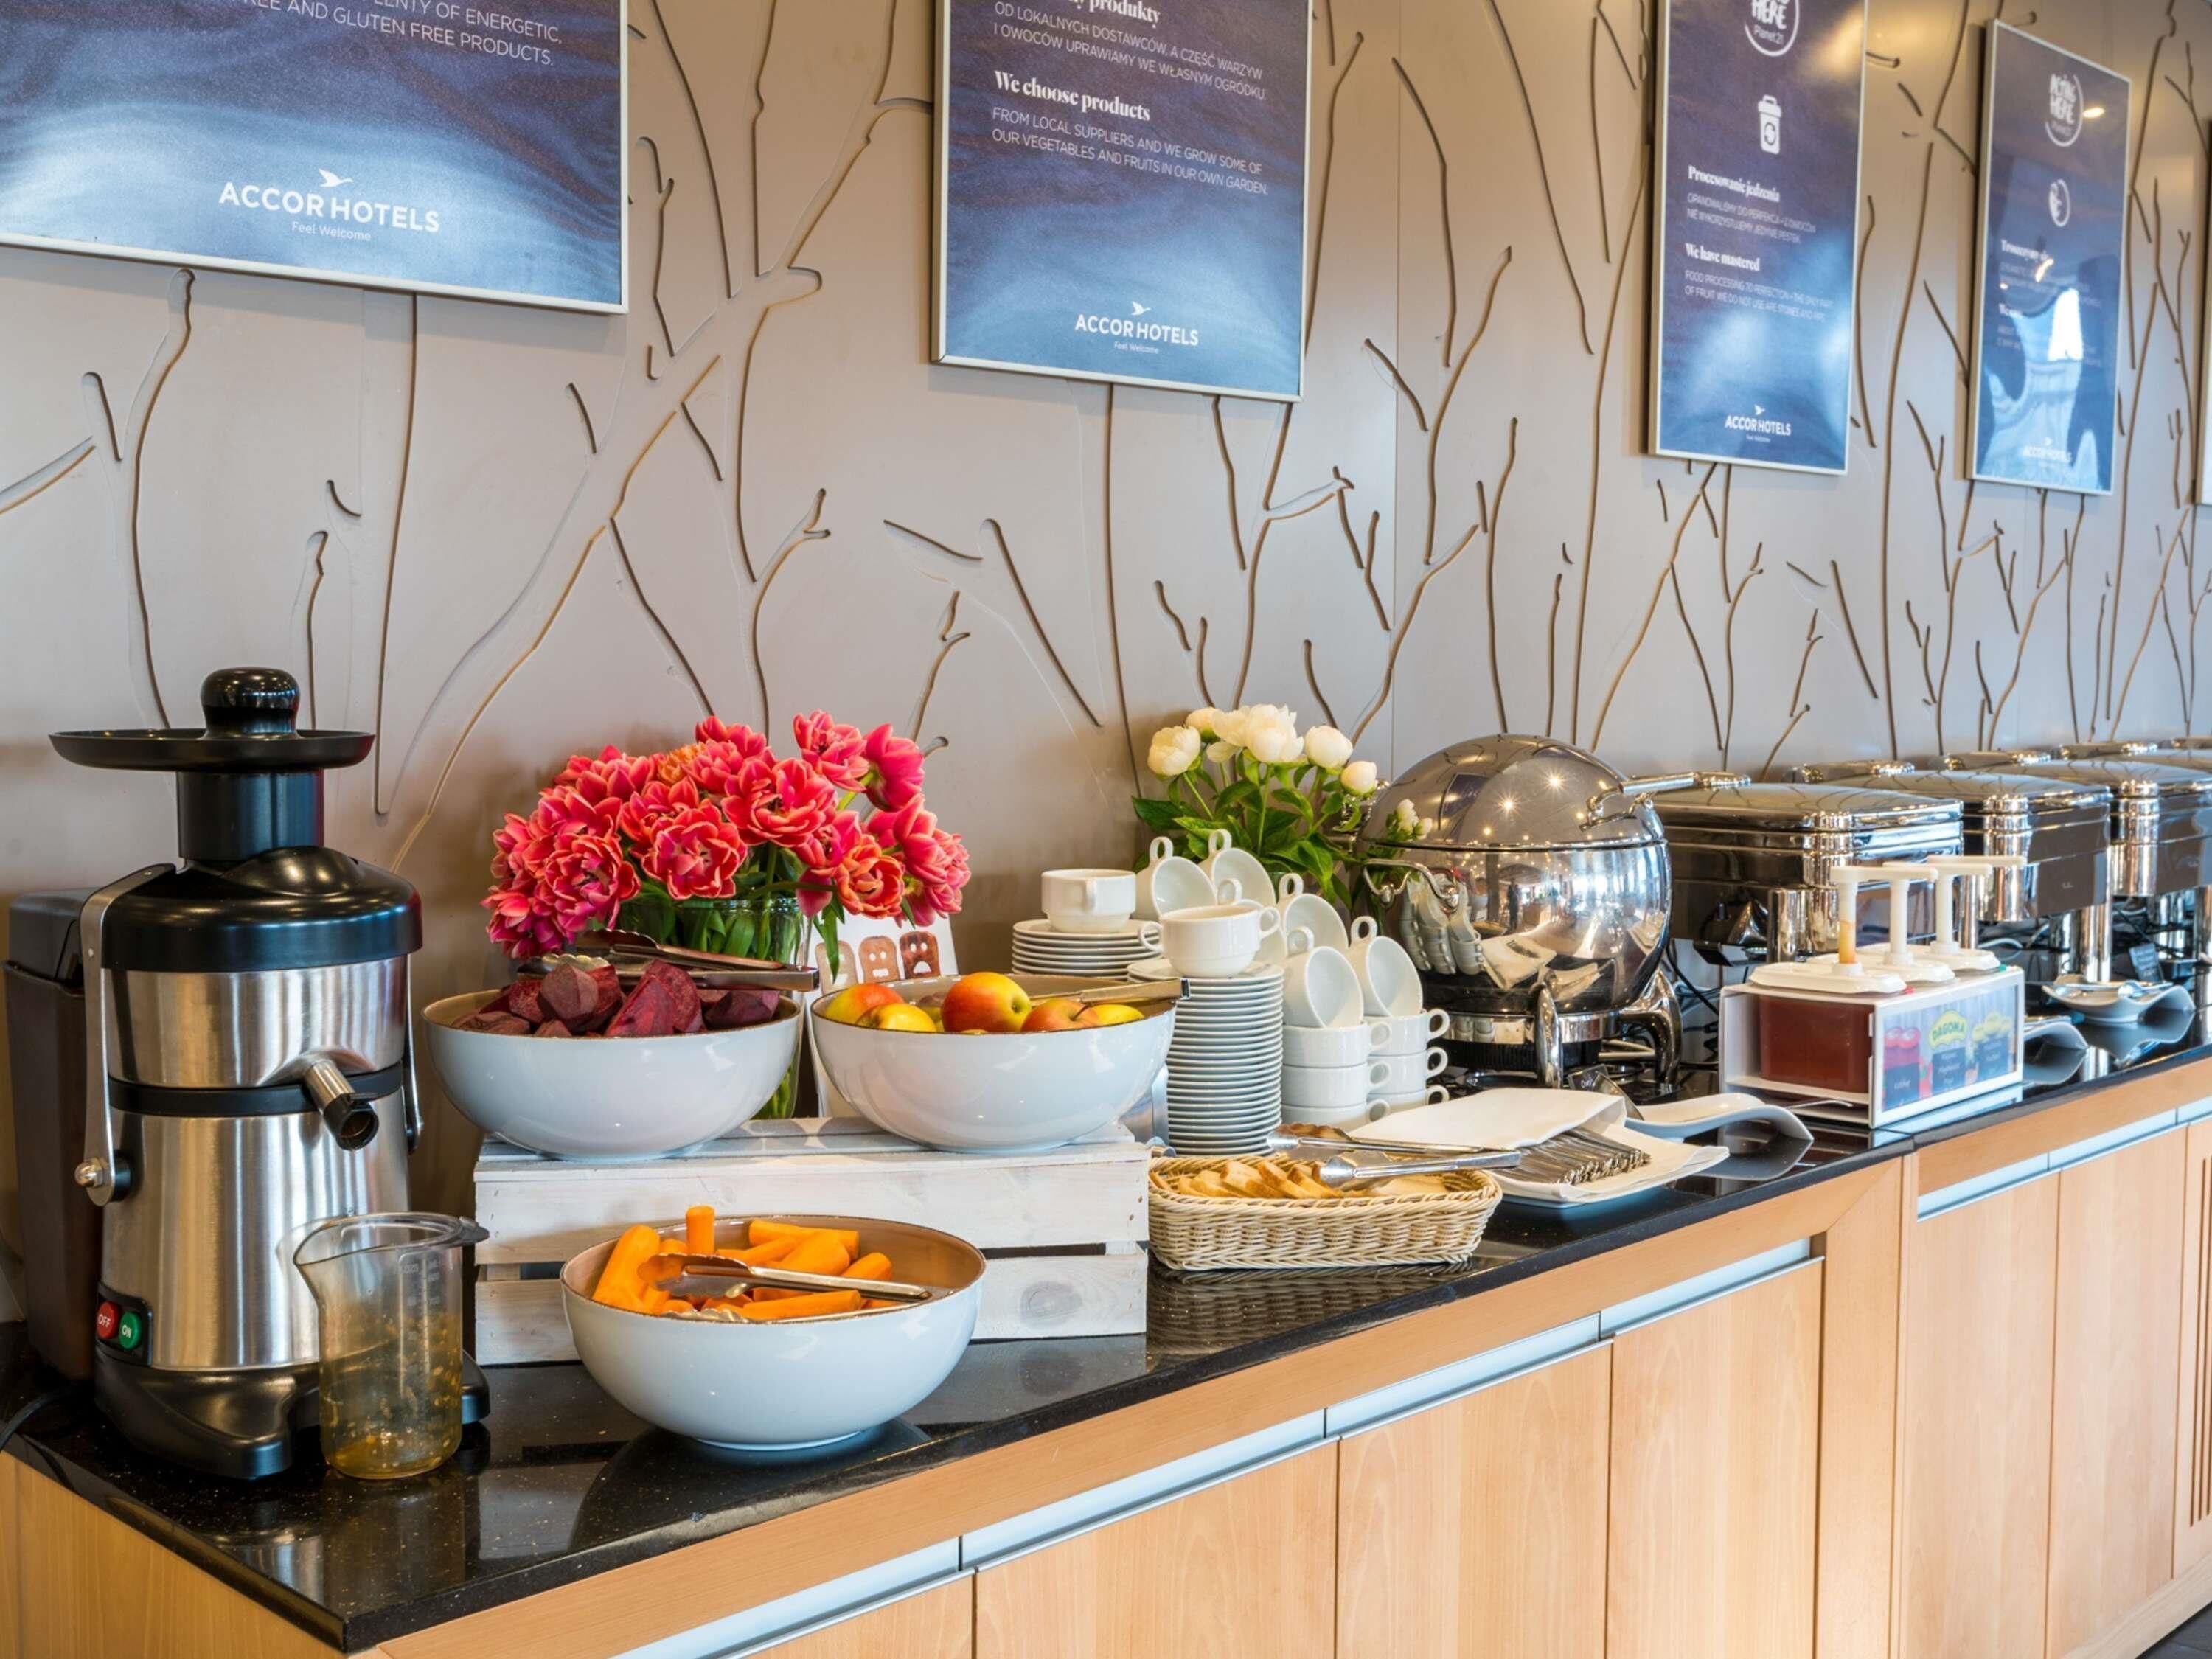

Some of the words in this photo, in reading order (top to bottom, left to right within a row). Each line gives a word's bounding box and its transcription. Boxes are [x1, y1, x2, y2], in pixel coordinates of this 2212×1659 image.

[287, 0, 328, 19] AND
[333, 7, 405, 35] GLUTEN
[411, 23, 455, 46] FREE
[461, 32, 553, 65] PRODUCTS.
[437, 3, 460, 19] OF
[466, 9, 562, 44] ENERGETIC,
[995, 1, 1014, 17] OD
[1017, 7, 1089, 35] LOKALNYCH
[1170, 46, 1178, 58] A
[1217, 57, 1263, 80] WARZYW
[993, 23, 998, 35] I
[1001, 24, 1063, 49] OWOCÓW
[1066, 39, 1136, 66] UPRAWIAMY
[1138, 58, 1157, 72] WE
[1158, 63, 1213, 86] WŁASNYM
[994, 70, 1020, 94] We
[1022, 77, 1079, 105] choose
[1081, 94, 1151, 122] products
[992, 107, 1030, 126] FROM
[1033, 115, 1071, 135] LOCAL
[1074, 124, 1135, 148] SUPPLIERS
[1137, 138, 1162, 154] AND
[1164, 142, 1182, 158] WE
[1184, 147, 1217, 165] GROW
[1219, 155, 1247, 173] SOME
[1249, 161, 1263, 175] OF
[992, 128, 1020, 145] OUR
[1022, 135, 1096, 160] VEGETABLES
[1097, 150, 1122, 164] AND
[1124, 154, 1161, 173] FRUITS
[1161, 162, 1172, 175] IN
[1174, 165, 1197, 181] OUR
[1198, 170, 1224, 186] OWN
[292, 221, 316, 234] Feel
[320, 225, 371, 241] Welcome
[1685, 243, 1699, 258] We
[1721, 254, 1760, 271] mastered
[97, 1313, 111, 1328] OFF
[122, 1324, 132, 1338] ON
